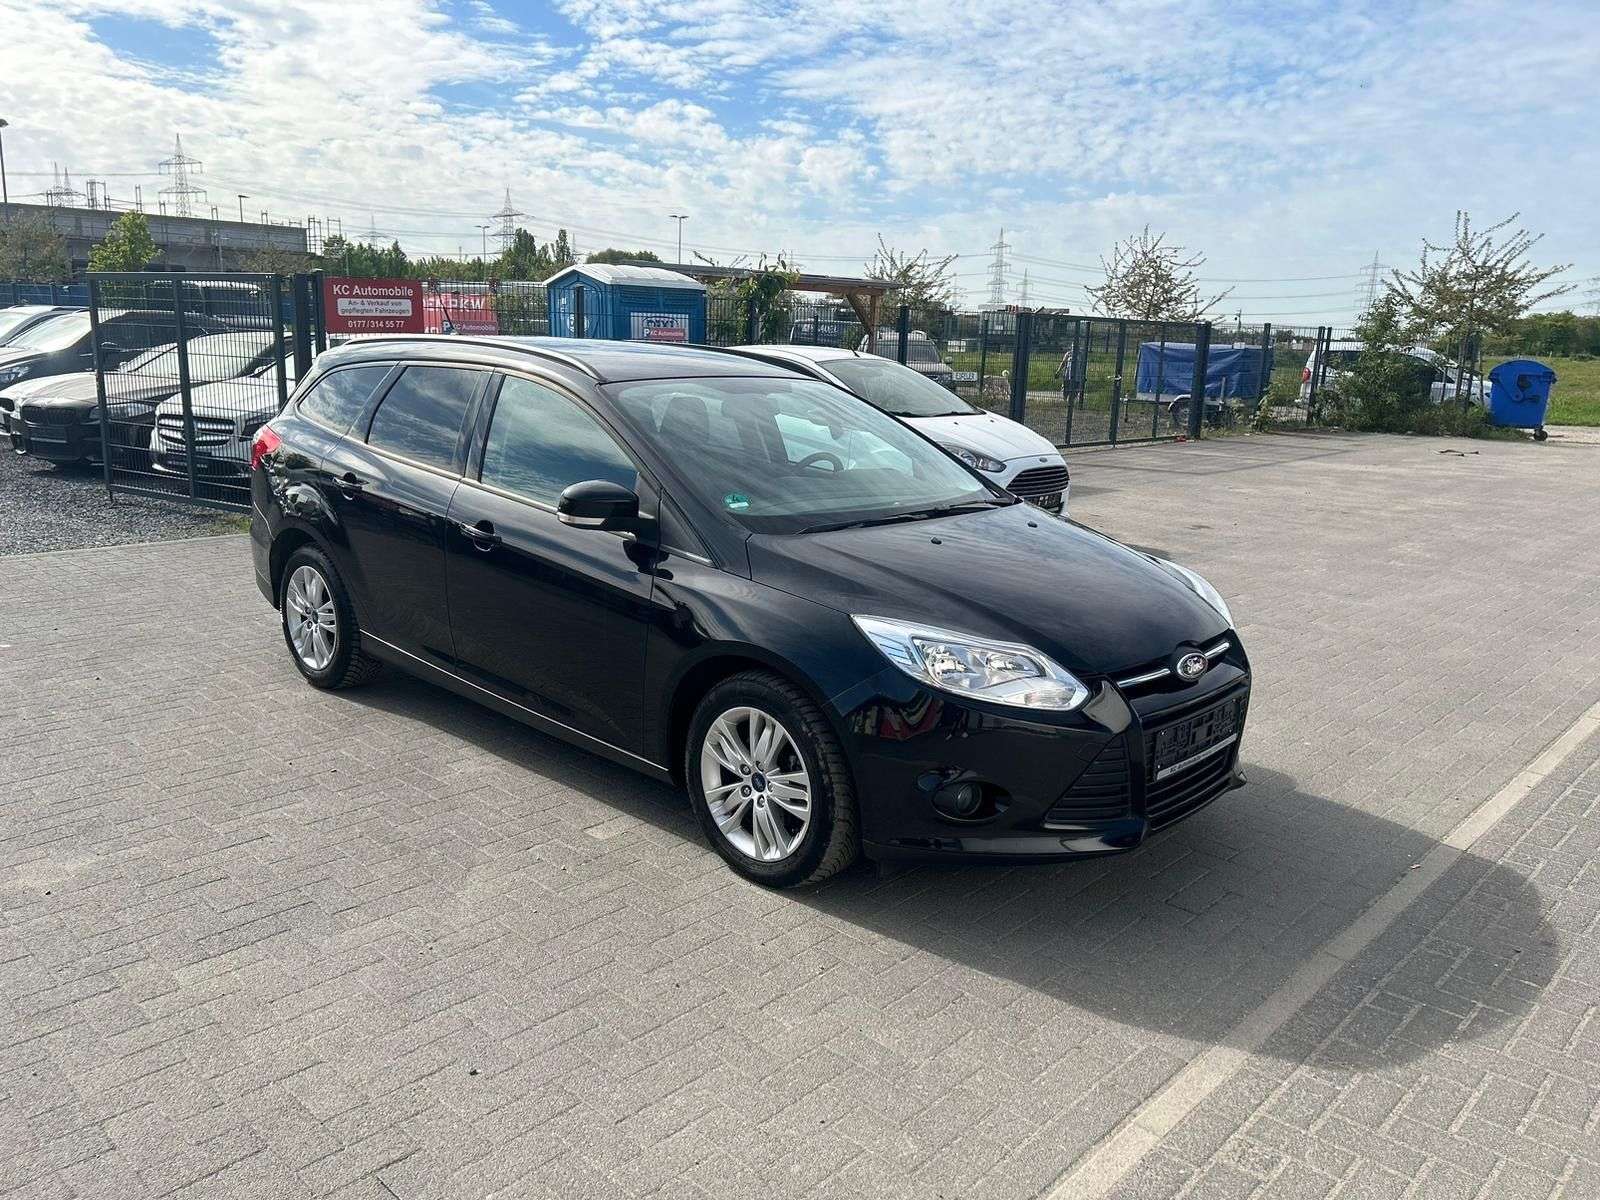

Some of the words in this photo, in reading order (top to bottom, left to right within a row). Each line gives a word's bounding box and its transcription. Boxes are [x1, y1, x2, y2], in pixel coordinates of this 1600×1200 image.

[333, 284, 350, 295] KC
[353, 285, 413, 296] Automobile
[375, 307, 410, 315] Fahrzeugen
[386, 320, 394, 328] 55
[395, 320, 404, 328] 77
